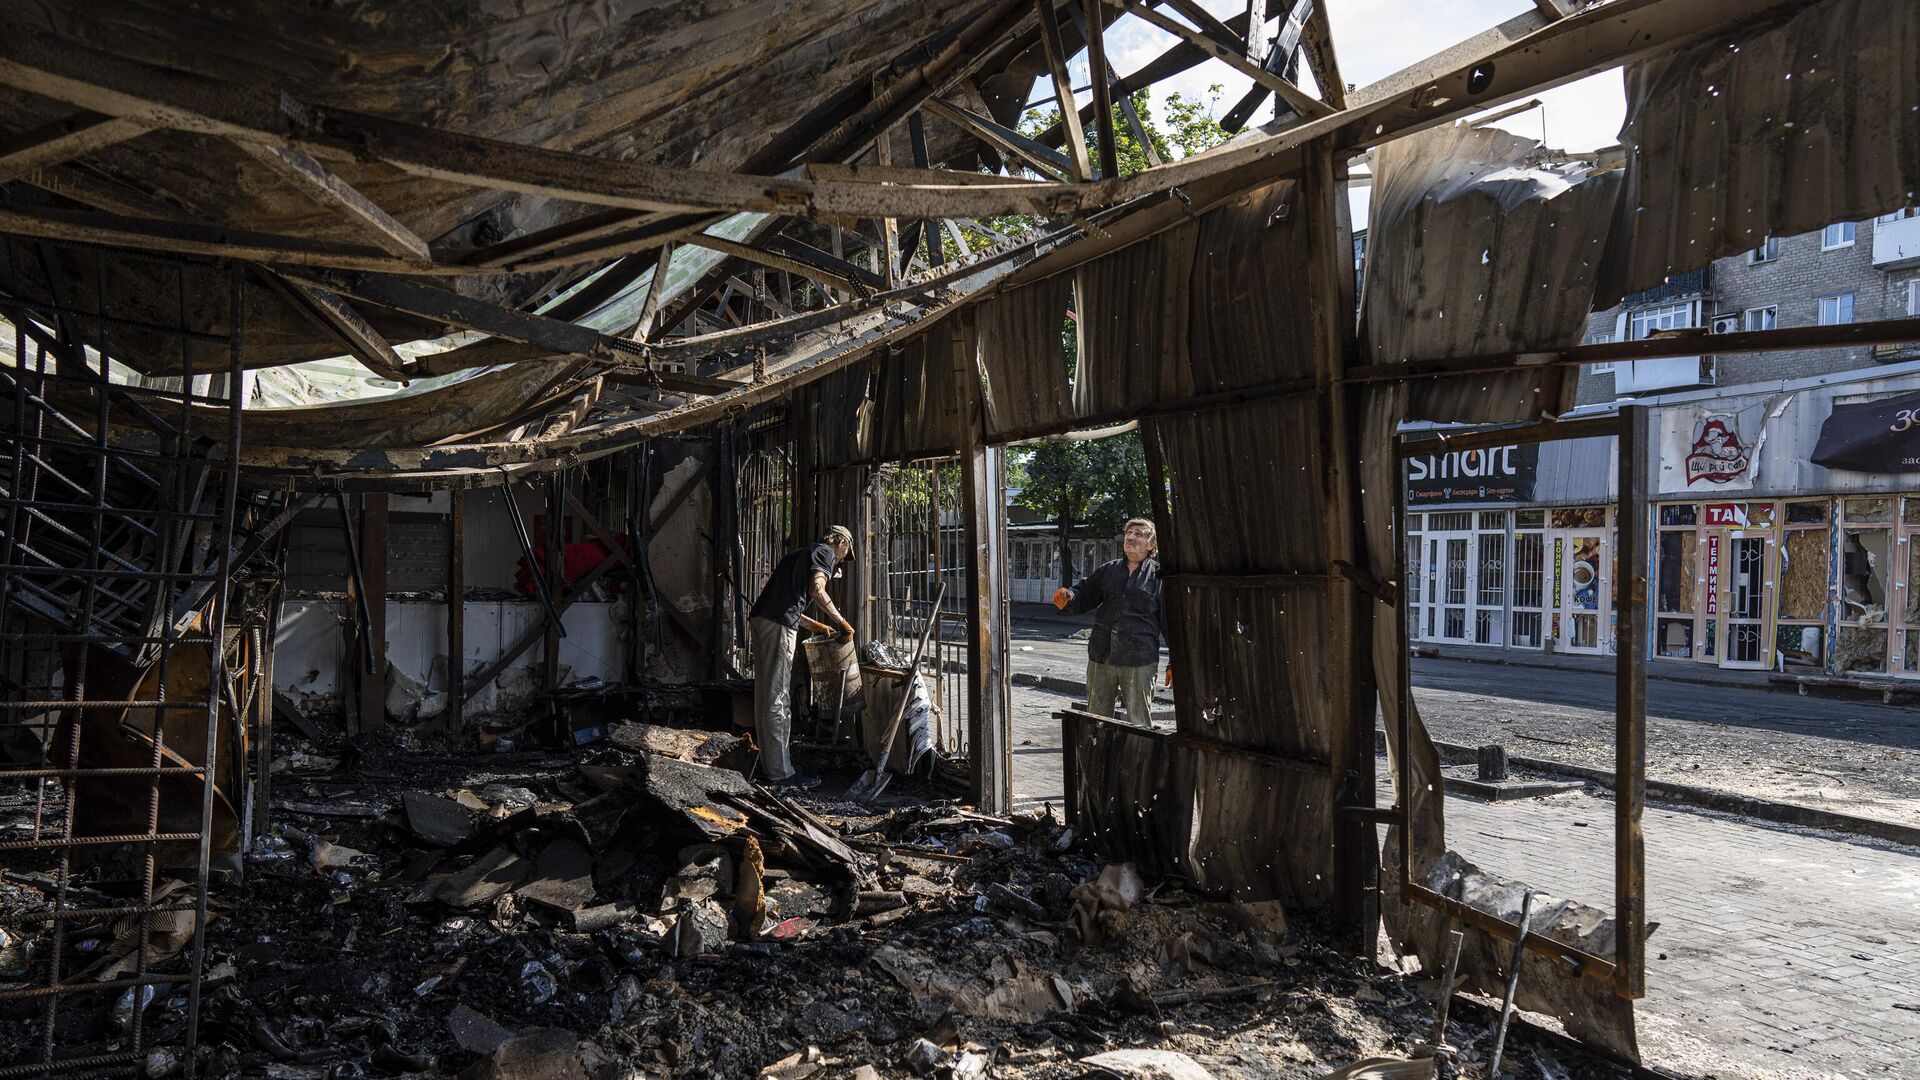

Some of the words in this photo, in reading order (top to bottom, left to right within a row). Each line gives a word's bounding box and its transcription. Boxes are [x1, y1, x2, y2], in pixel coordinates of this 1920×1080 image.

[1409, 445, 1518, 480] smart
[1554, 540, 1562, 607] КОНДИТЕРКА
[1708, 537, 1718, 612] ТЕРМИНАЛ
